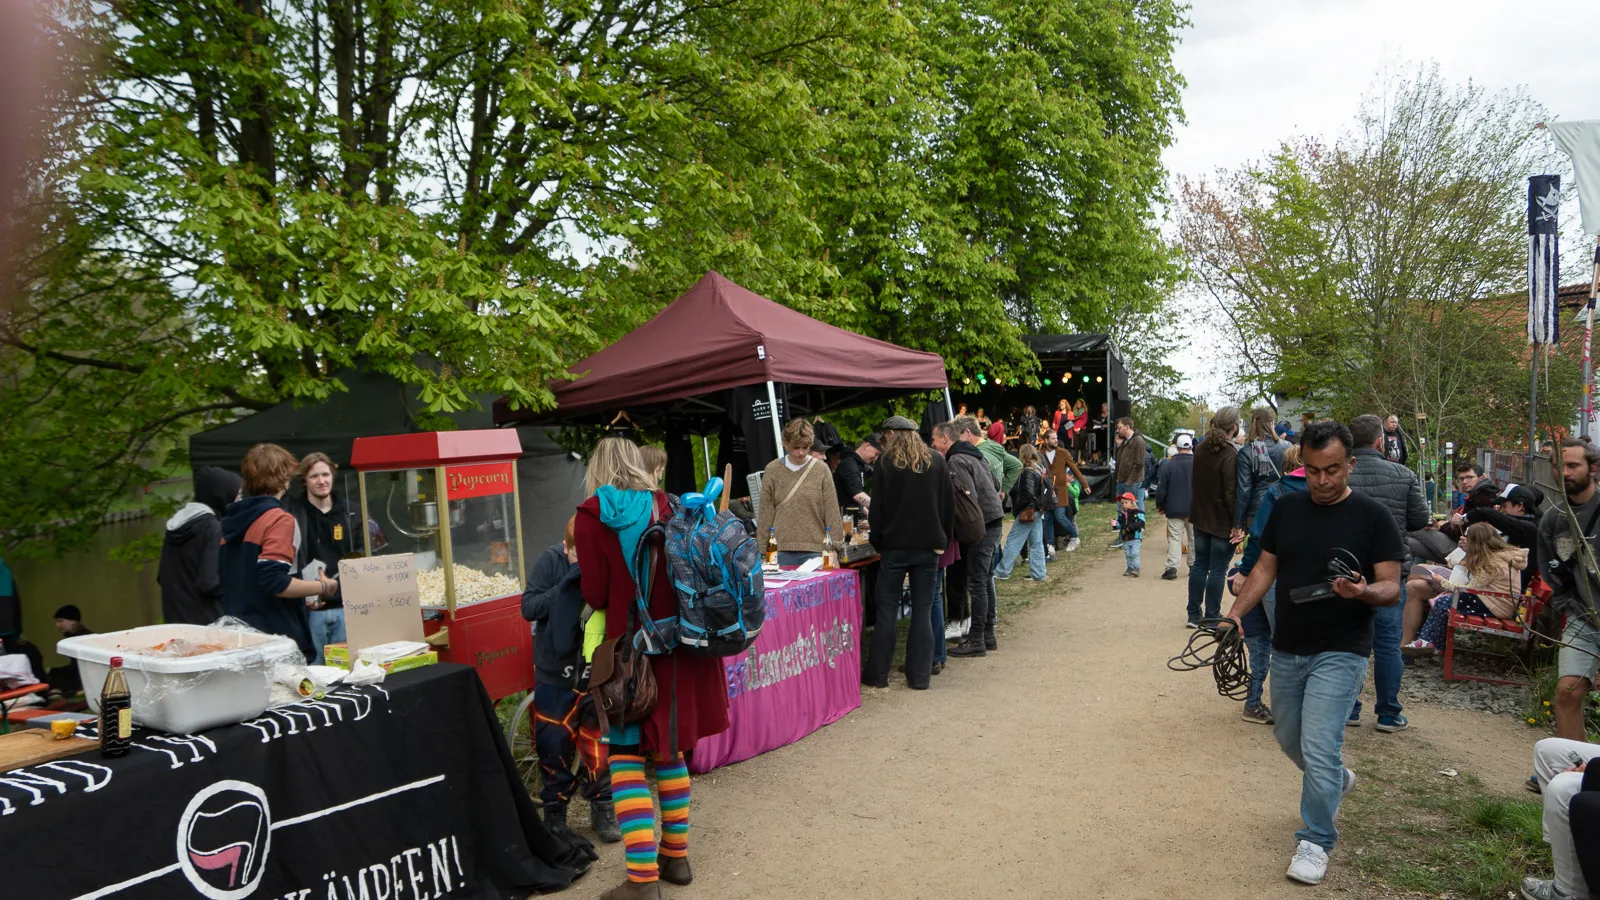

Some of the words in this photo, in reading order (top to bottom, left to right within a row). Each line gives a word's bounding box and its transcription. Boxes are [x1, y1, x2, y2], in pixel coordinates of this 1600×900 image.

[448, 472, 510, 491] Popcorn
[474, 645, 518, 668] Popcorn
[0, 760, 113, 816] ND
